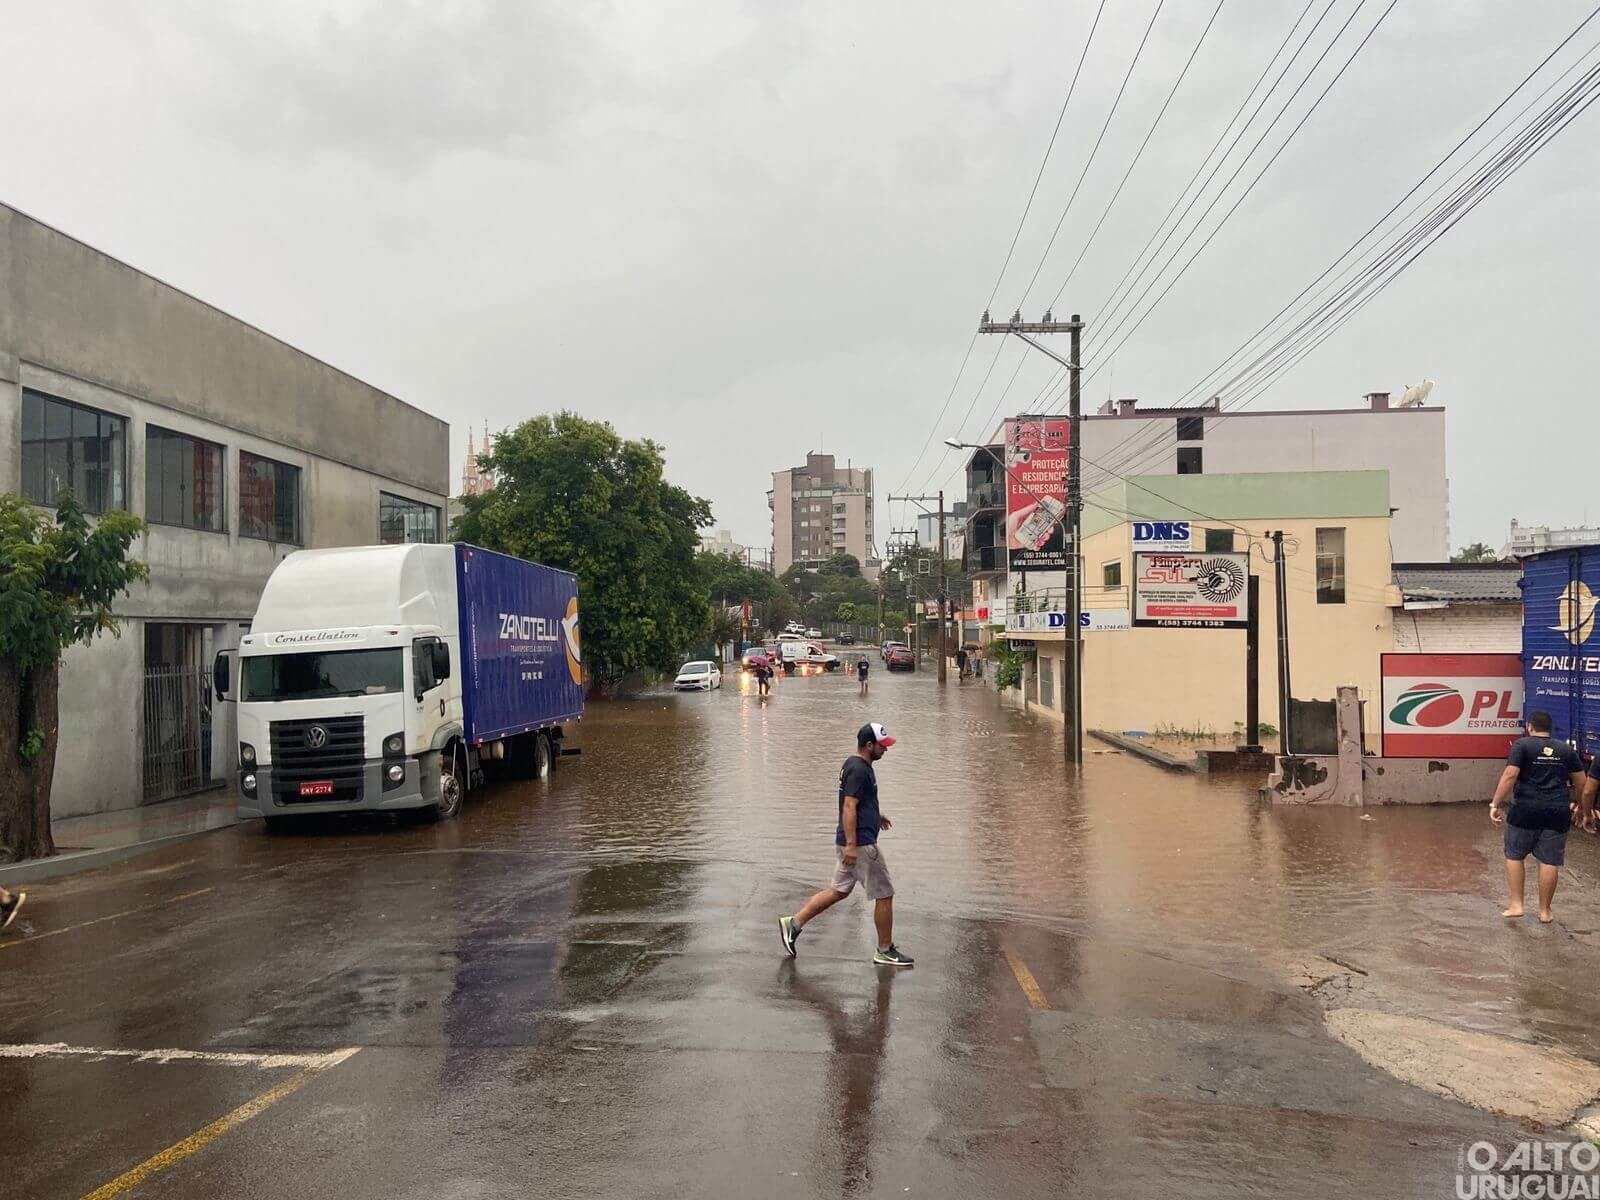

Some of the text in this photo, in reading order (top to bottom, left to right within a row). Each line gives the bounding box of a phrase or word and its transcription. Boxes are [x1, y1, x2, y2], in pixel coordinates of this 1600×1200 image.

[1022, 471, 1069, 482] RESIDENCIA
[1012, 483, 1069, 494] E EMPRESARI
[1133, 522, 1190, 541] DNS
[1048, 612, 1091, 627] DS
[499, 613, 559, 641] ZANOTELLI
[275, 631, 359, 643] Constellation
[1541, 676, 1577, 684] TRANSPORES
[1469, 690, 1520, 719] PL
